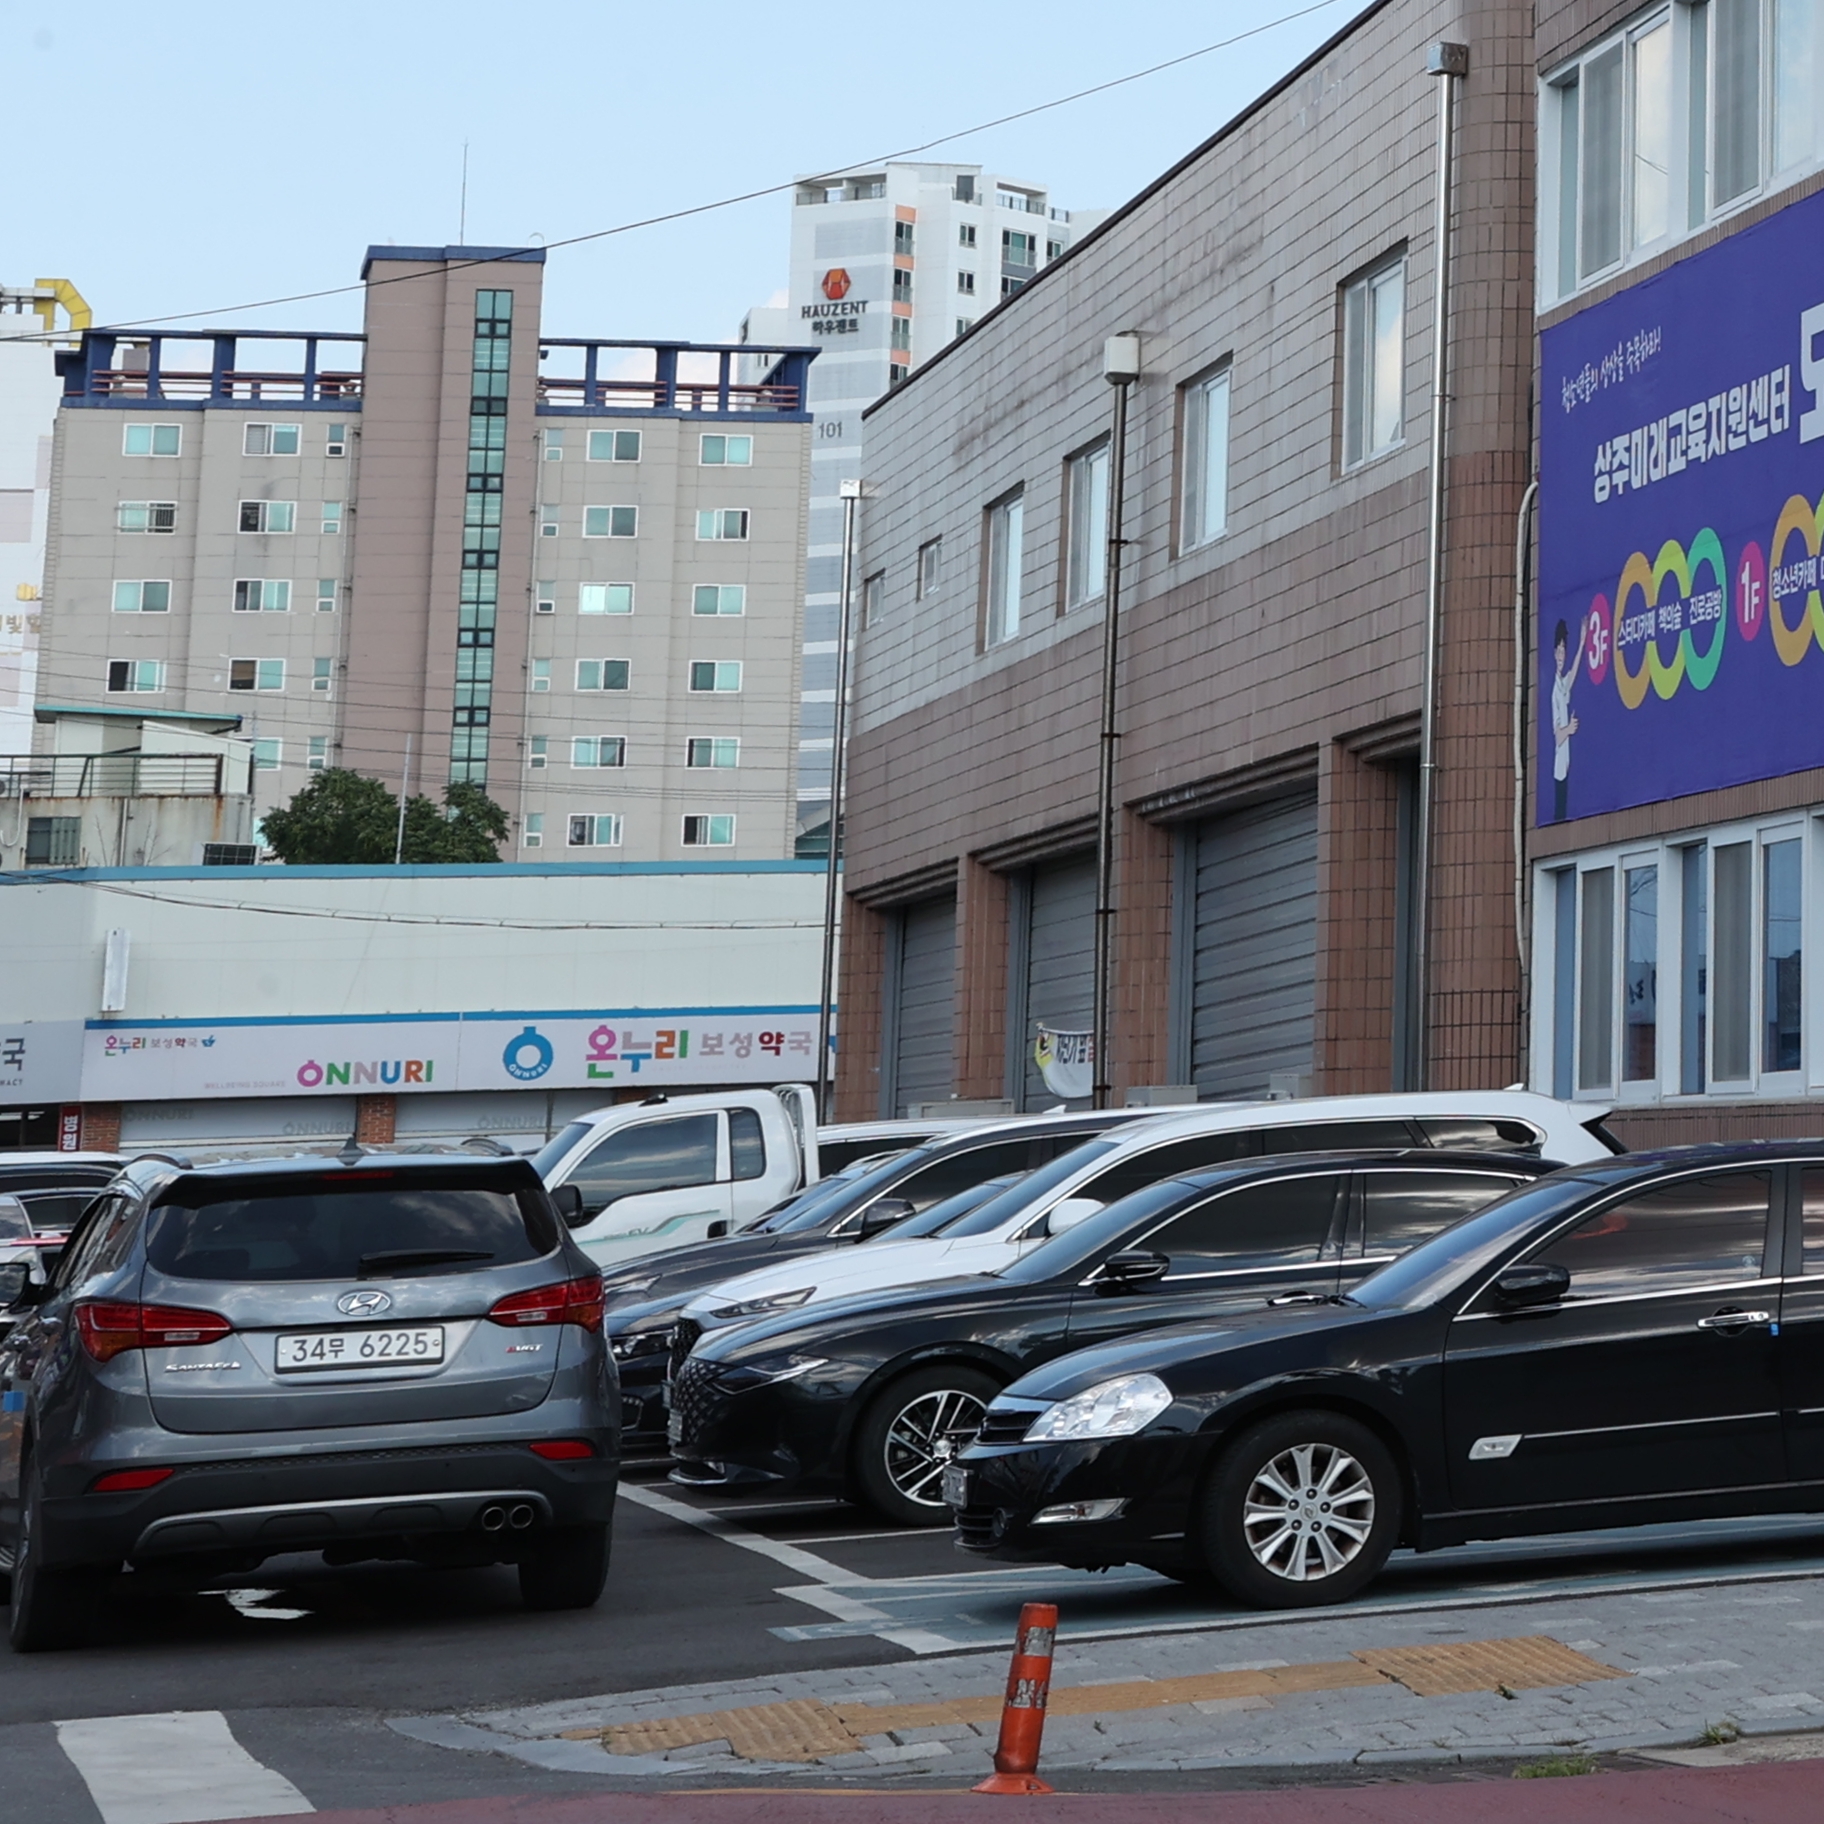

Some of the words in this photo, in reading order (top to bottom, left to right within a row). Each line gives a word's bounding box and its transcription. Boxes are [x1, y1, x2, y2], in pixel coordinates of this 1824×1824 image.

[801, 300, 868, 319] HAUZENT
[819, 421, 842, 439] 101
[1594, 364, 1790, 504] 상주미래교육지원센터
[1741, 561, 1761, 624] 1F
[1772, 557, 1817, 601] 청소년카페
[1588, 611, 1609, 670] 3F
[105, 1035, 146, 1057] 온누리
[150, 1037, 198, 1049] 보성약국
[586, 1025, 689, 1078] 온누리
[699, 1031, 812, 1056] 보성약국
[297, 1060, 433, 1088] ONNURI
[291, 1338, 346, 1363] 34무
[359, 1332, 429, 1359] 6225
